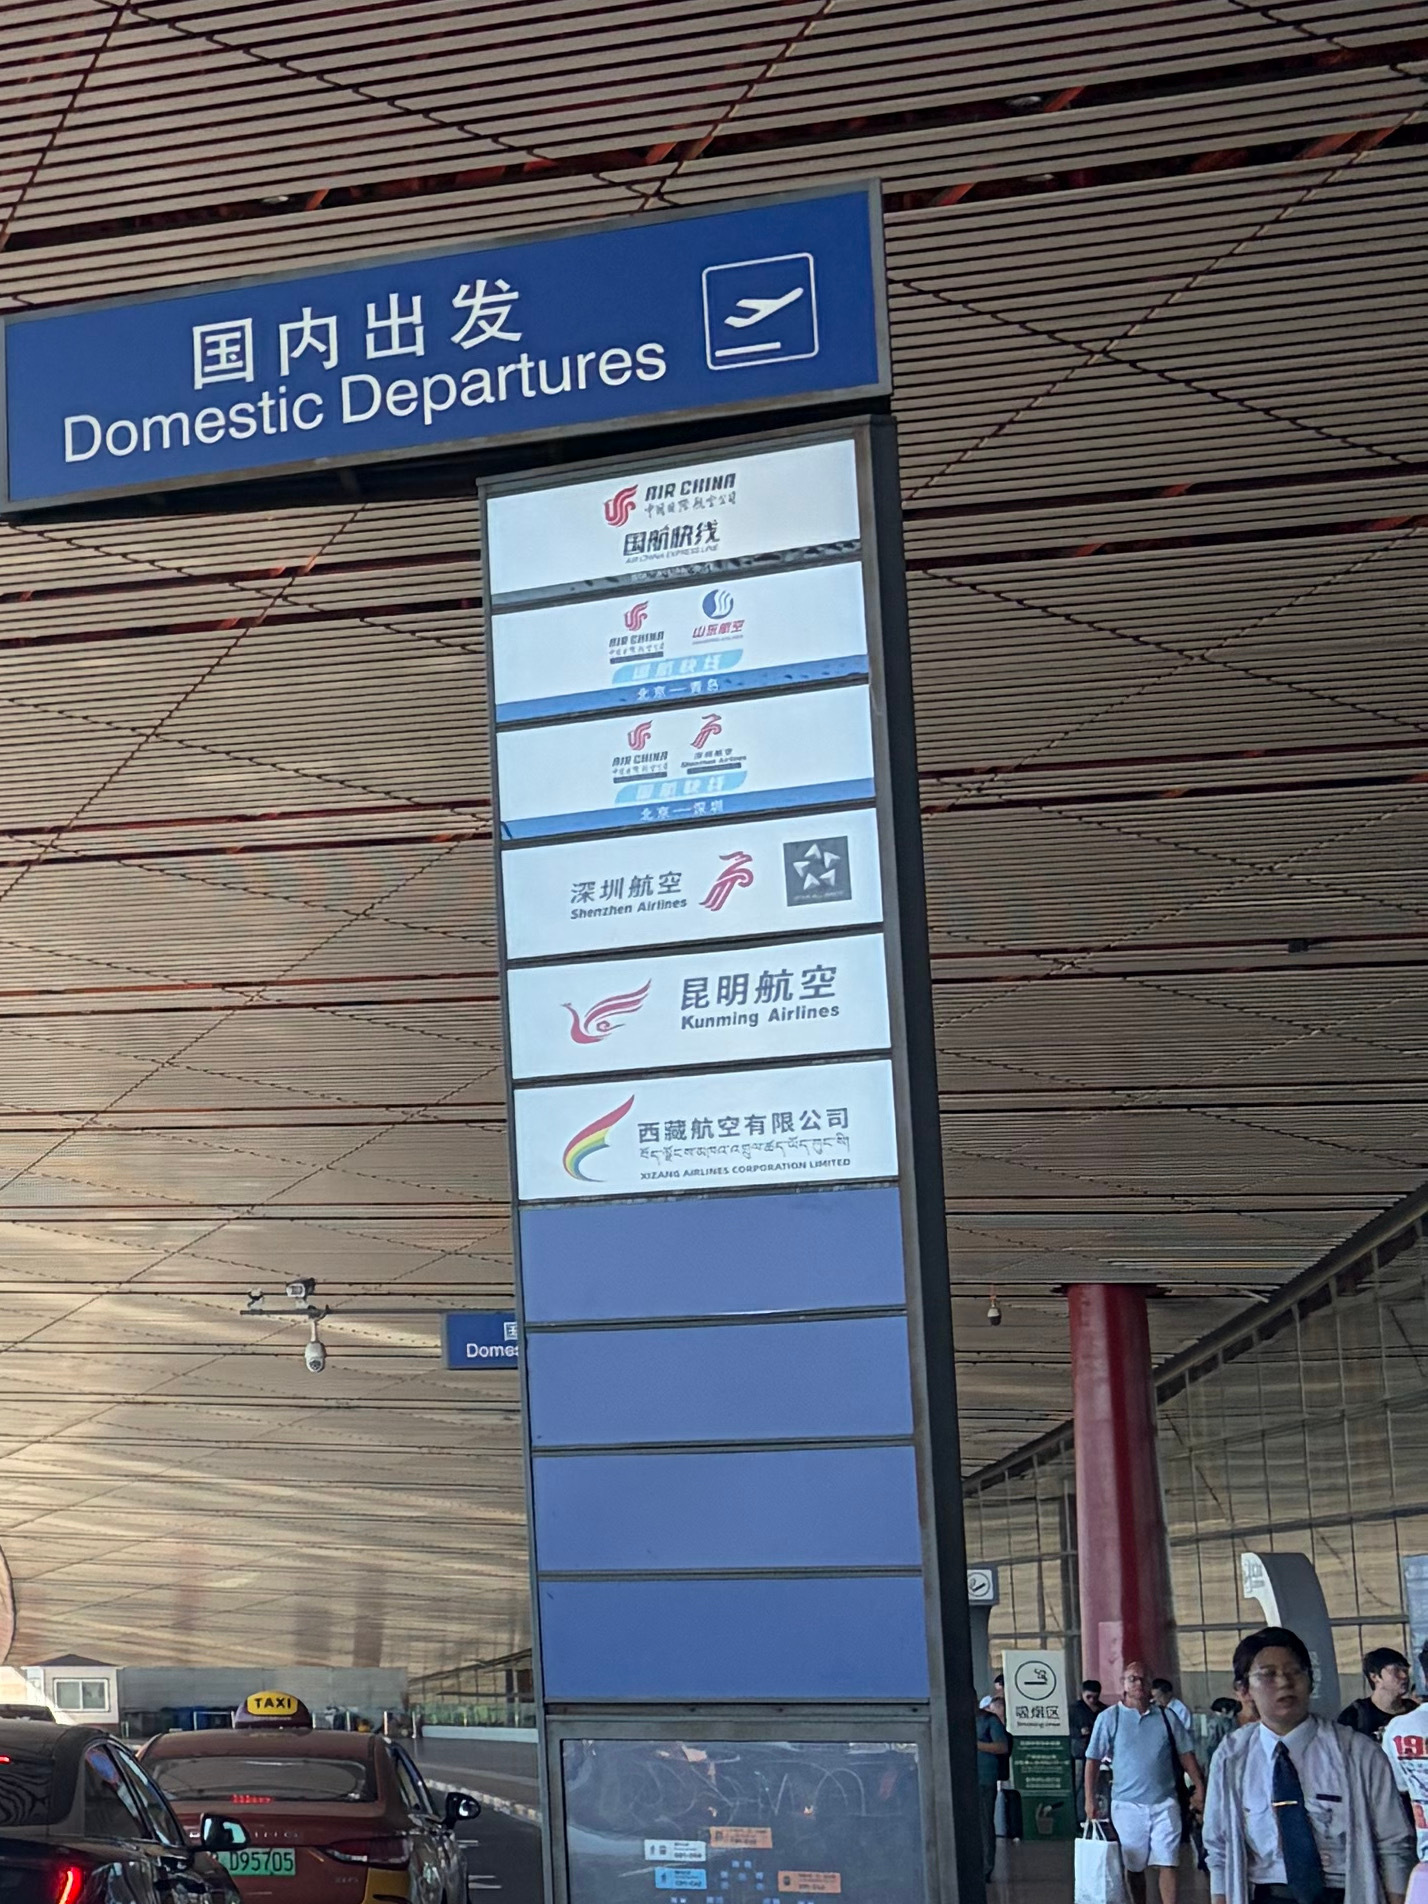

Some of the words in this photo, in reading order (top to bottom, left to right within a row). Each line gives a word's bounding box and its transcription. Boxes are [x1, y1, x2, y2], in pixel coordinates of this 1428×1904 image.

[191, 277, 524, 390] 国内出发
[62, 385, 325, 464] Domestic
[340, 336, 668, 425] Departures
[645, 482, 676, 502] AIR
[680, 472, 737, 496] CHINA
[623, 519, 721, 557] 国航快线
[692, 619, 745, 638] 山东航空
[570, 870, 684, 905] 深圳航空
[570, 903, 633, 920] Shenzhen
[637, 897, 688, 913] Airlines
[680, 964, 838, 1012] 昆明航空
[681, 1010, 759, 1031] Kunming
[768, 1004, 840, 1024] Airlines
[637, 1108, 849, 1144] 西藏航空有限公司
[640, 1169, 680, 1180] XIZANG
[683, 1166, 730, 1177] AIRLINES
[732, 1160, 807, 1174] CORPORATION
[809, 1158, 851, 1170] LIMITED
[254, 1697, 292, 1709] TAXI
[229, 1851, 294, 1872] D95705
